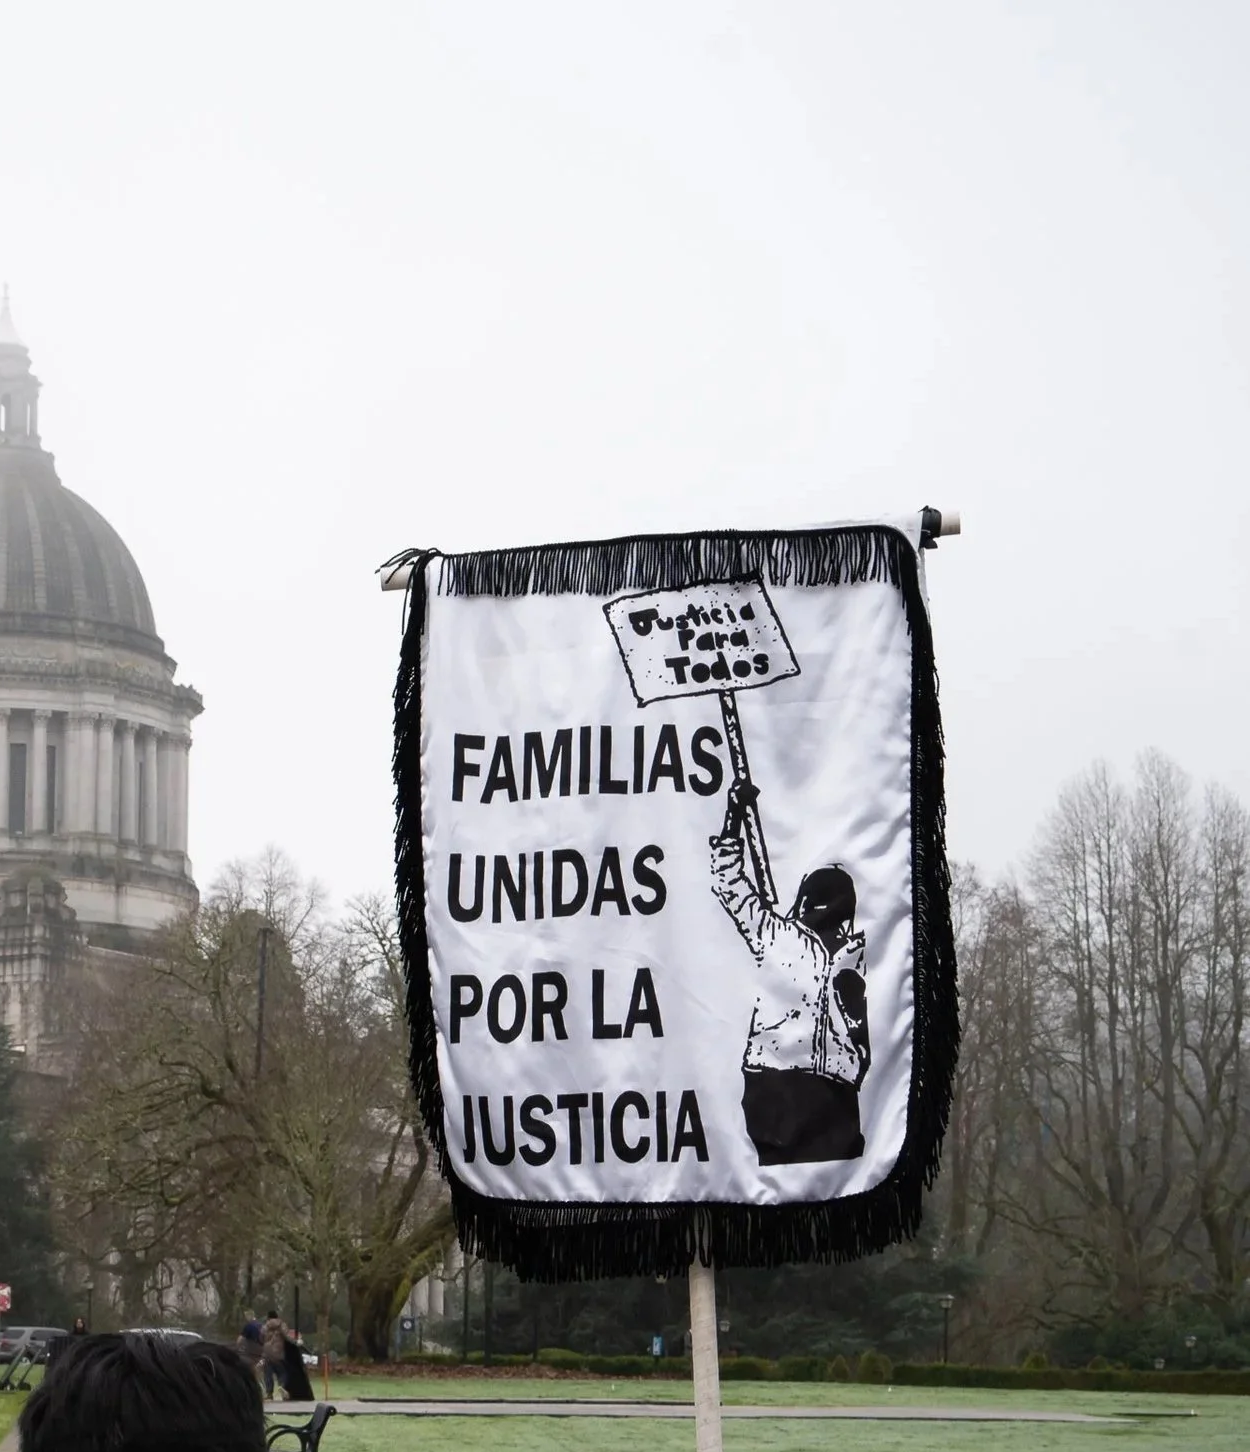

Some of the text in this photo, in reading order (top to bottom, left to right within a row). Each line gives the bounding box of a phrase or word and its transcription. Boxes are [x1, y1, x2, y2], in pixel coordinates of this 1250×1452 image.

[628, 602, 755, 637] Justicia
[677, 629, 749, 651] Para
[664, 651, 769, 685] Todos
[452, 724, 724, 804] FAMILIAS
[447, 844, 667, 924] UNIDAS
[450, 967, 664, 1044] POR LA
[462, 1089, 710, 1165] JUSTICIA
